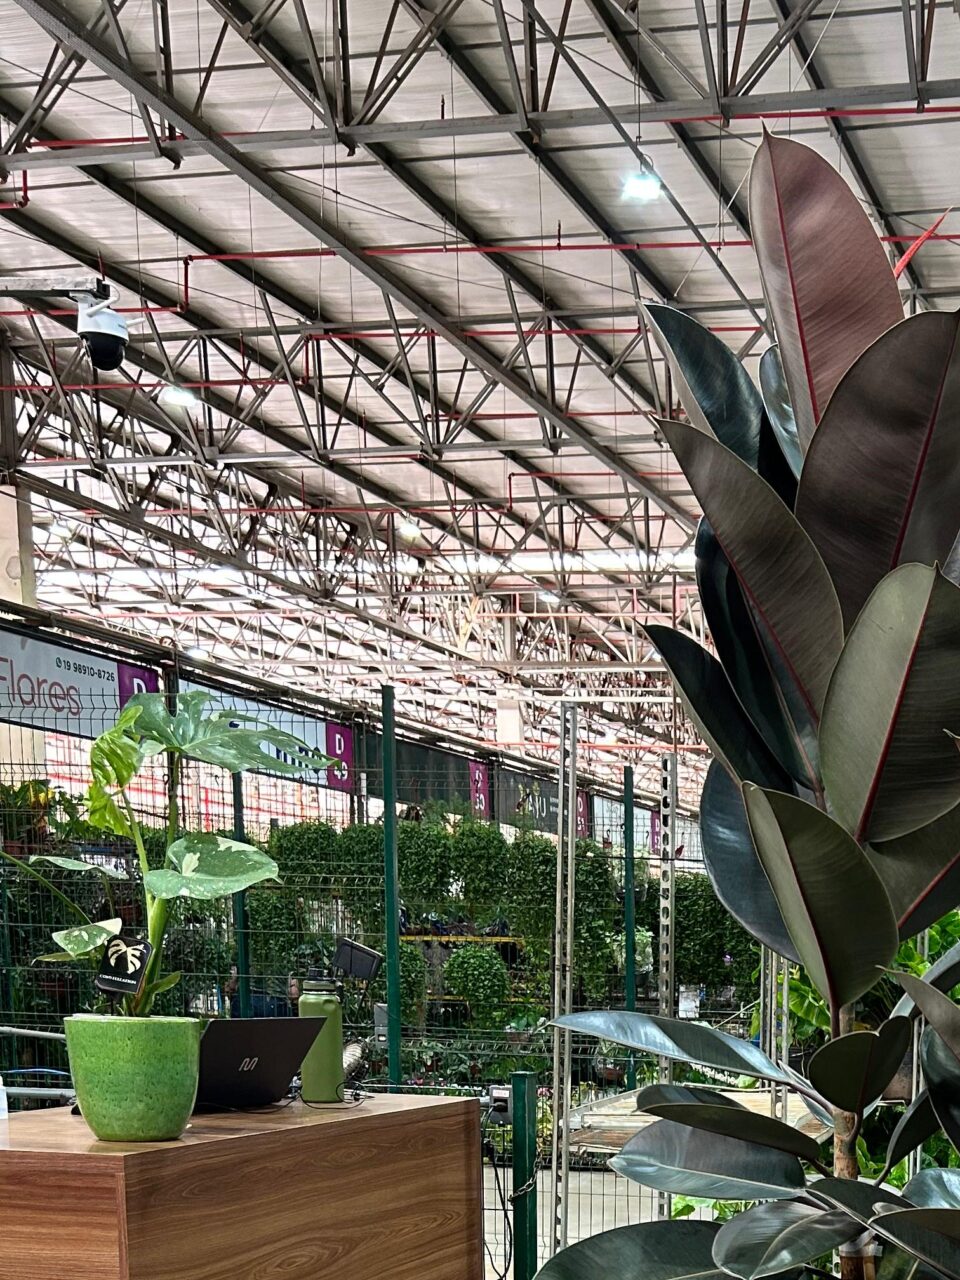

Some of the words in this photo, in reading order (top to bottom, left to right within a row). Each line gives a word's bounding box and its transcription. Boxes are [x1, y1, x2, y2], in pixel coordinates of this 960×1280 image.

[62, 659, 71, 671] 19
[73, 662, 116, 682] 98910-8726
[335, 733, 344, 755] D
